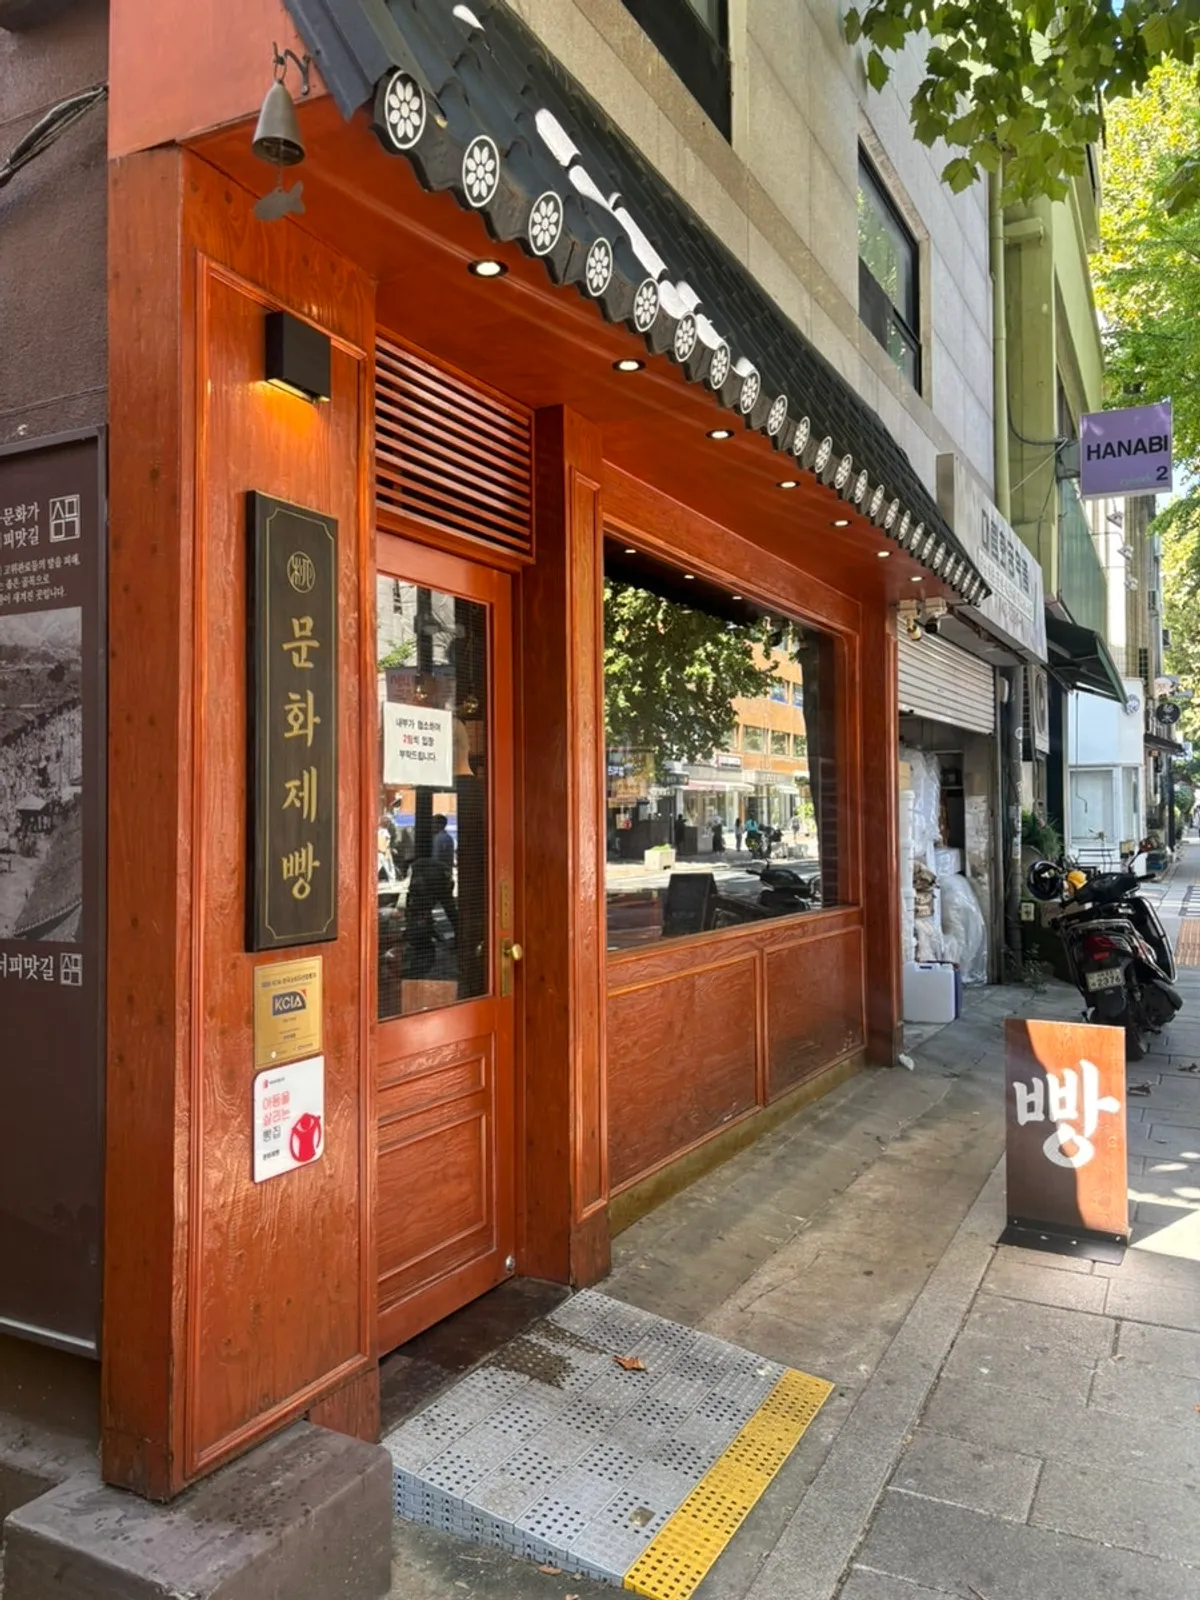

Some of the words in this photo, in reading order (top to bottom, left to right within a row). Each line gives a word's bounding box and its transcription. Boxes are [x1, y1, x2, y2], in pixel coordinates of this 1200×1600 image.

[1086, 434, 1168, 461] HANABI
[1156, 465, 1168, 481] 2
[0, 502, 39, 526] 문화가
[0, 525, 39, 549] 피맛길
[395, 718, 415, 730] 내부가
[281, 615, 321, 899] 문화제빵
[274, 994, 303, 1012] KCIA
[1012, 1058, 1121, 1169] 빵
